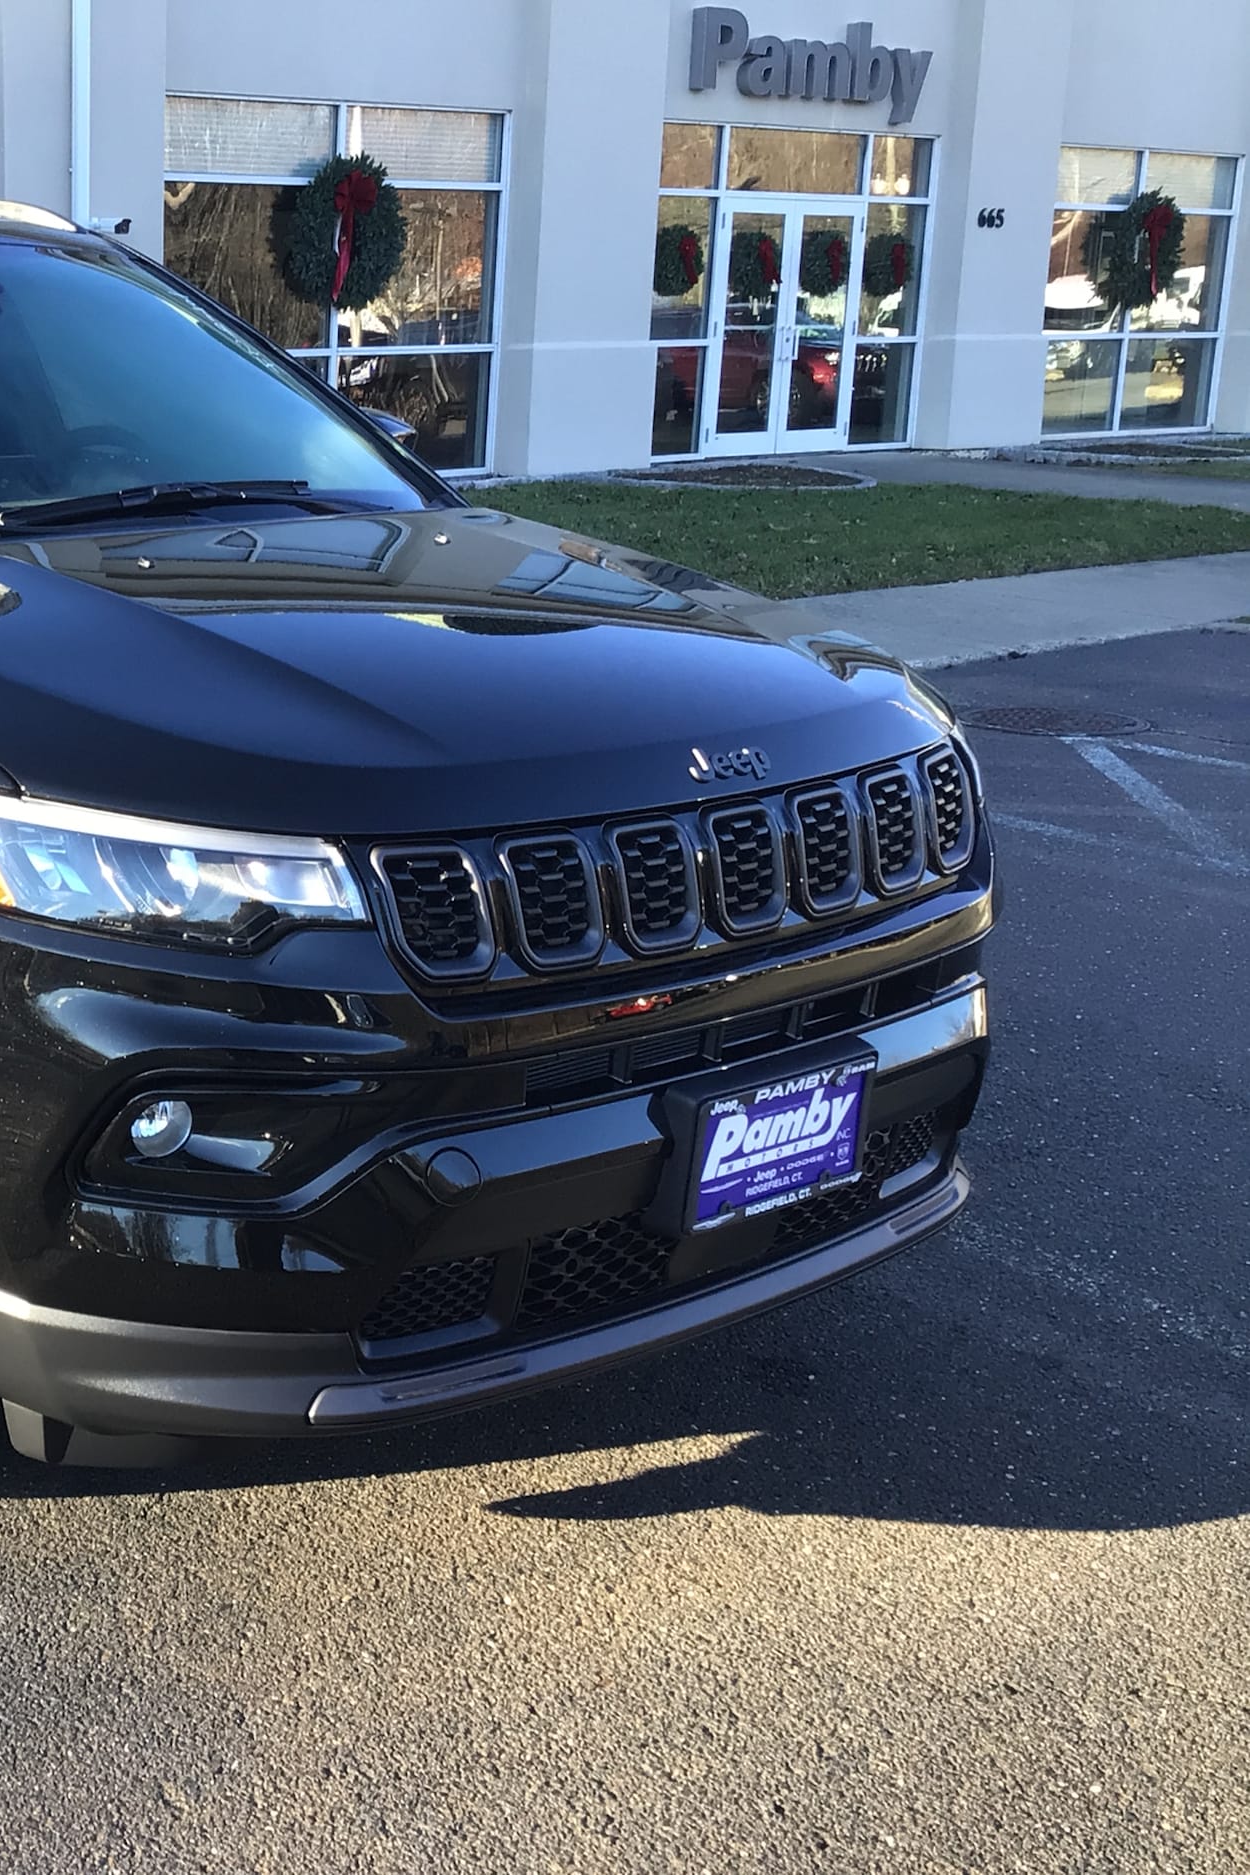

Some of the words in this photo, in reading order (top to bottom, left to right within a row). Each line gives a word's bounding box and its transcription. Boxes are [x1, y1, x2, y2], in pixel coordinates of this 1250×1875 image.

[689, 7, 933, 125] Pamby
[978, 208, 1005, 228] 665
[688, 747, 771, 783] Jeep
[754, 1069, 836, 1104] PAMBY
[710, 1099, 739, 1116] Jeep
[700, 1087, 858, 1183] Pamby
[726, 1138, 814, 1173] MOTORS
[753, 1168, 777, 1183] Jeep
[745, 1191, 798, 1217] RIDGEFIELD,
